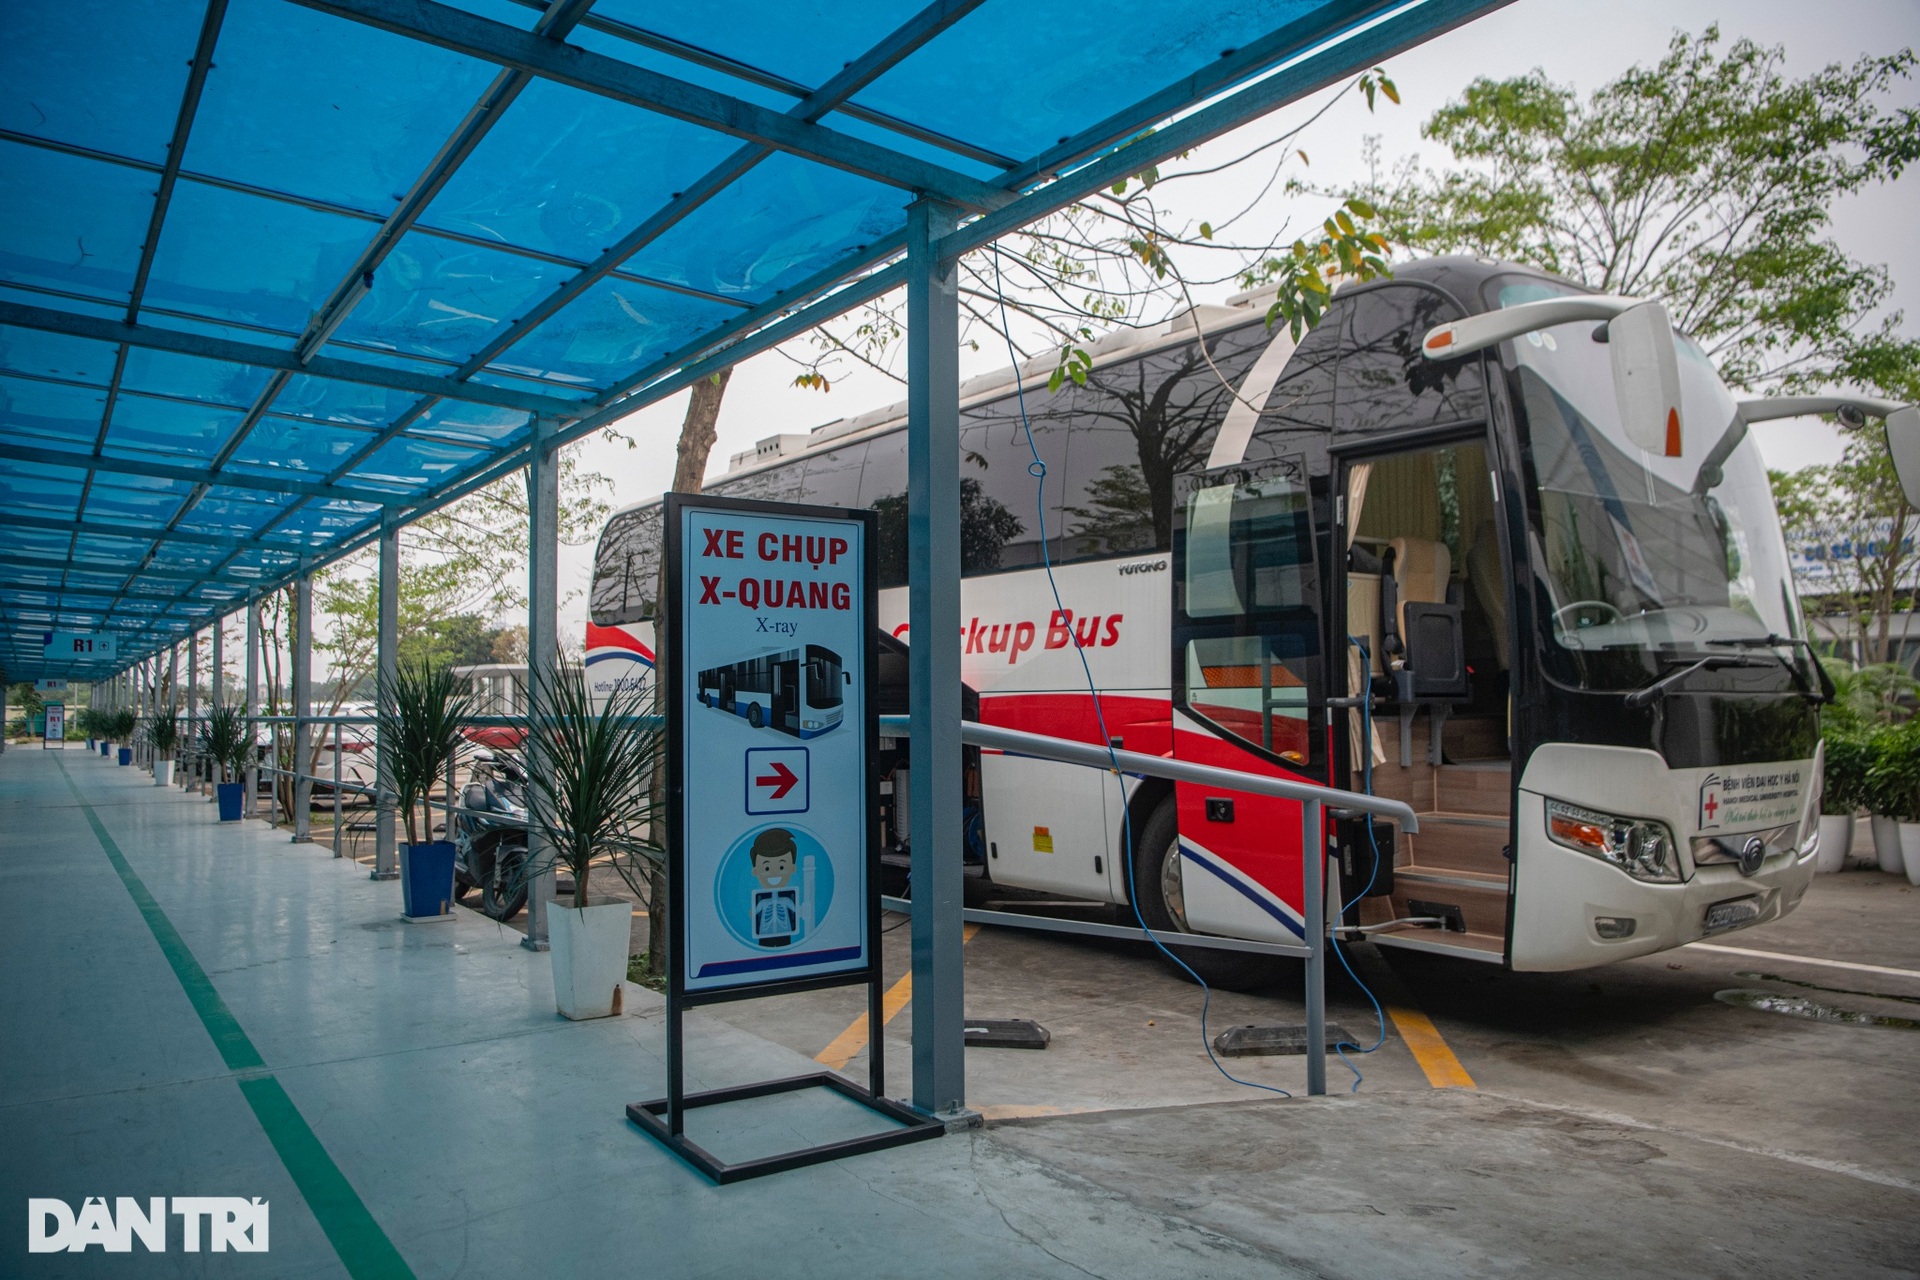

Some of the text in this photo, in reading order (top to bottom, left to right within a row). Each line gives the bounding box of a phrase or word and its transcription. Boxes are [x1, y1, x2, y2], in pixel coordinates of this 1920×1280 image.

[702, 528, 848, 570] XE CHỤP
[1117, 559, 1167, 576] YUTONG
[699, 576, 850, 610] X-QUANG
[756, 617, 798, 637] X-ray
[1044, 608, 1123, 649] Bus
[73, 639, 93, 652] R1
[594, 681, 613, 692] Hotline:
[1780, 773, 1784, 785] Y
